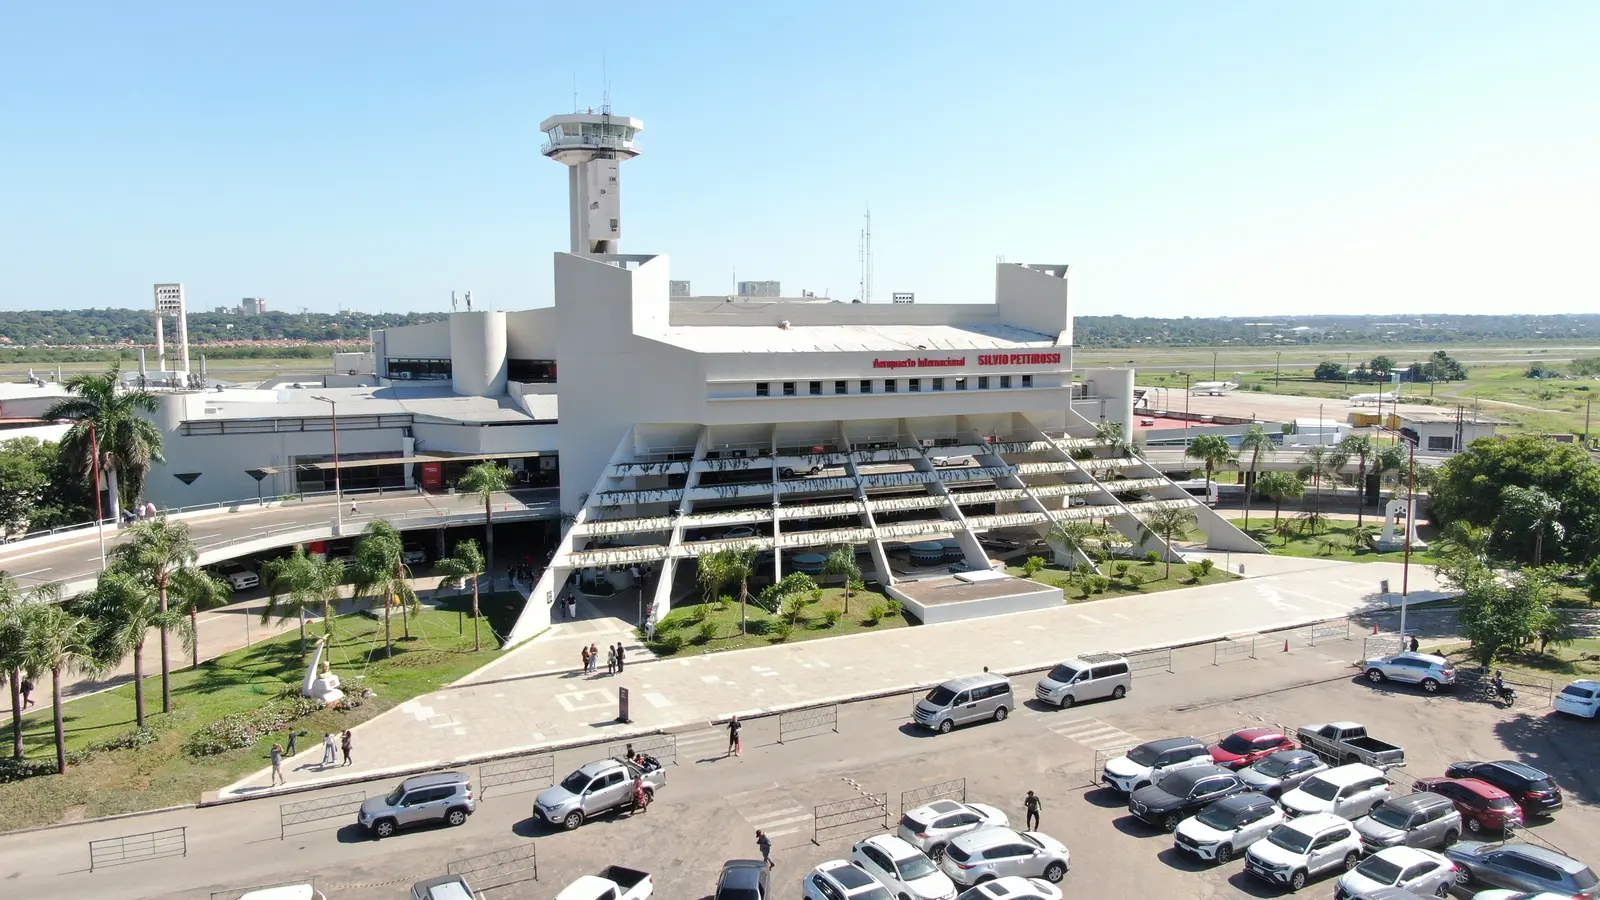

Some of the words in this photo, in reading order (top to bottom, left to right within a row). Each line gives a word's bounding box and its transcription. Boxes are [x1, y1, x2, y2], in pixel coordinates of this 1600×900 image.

[873, 358, 916, 370] Aeropuerto
[917, 356, 966, 368] Internacional
[978, 354, 1009, 366] SILVIO
[1010, 352, 1061, 365] PETTIROSSI
